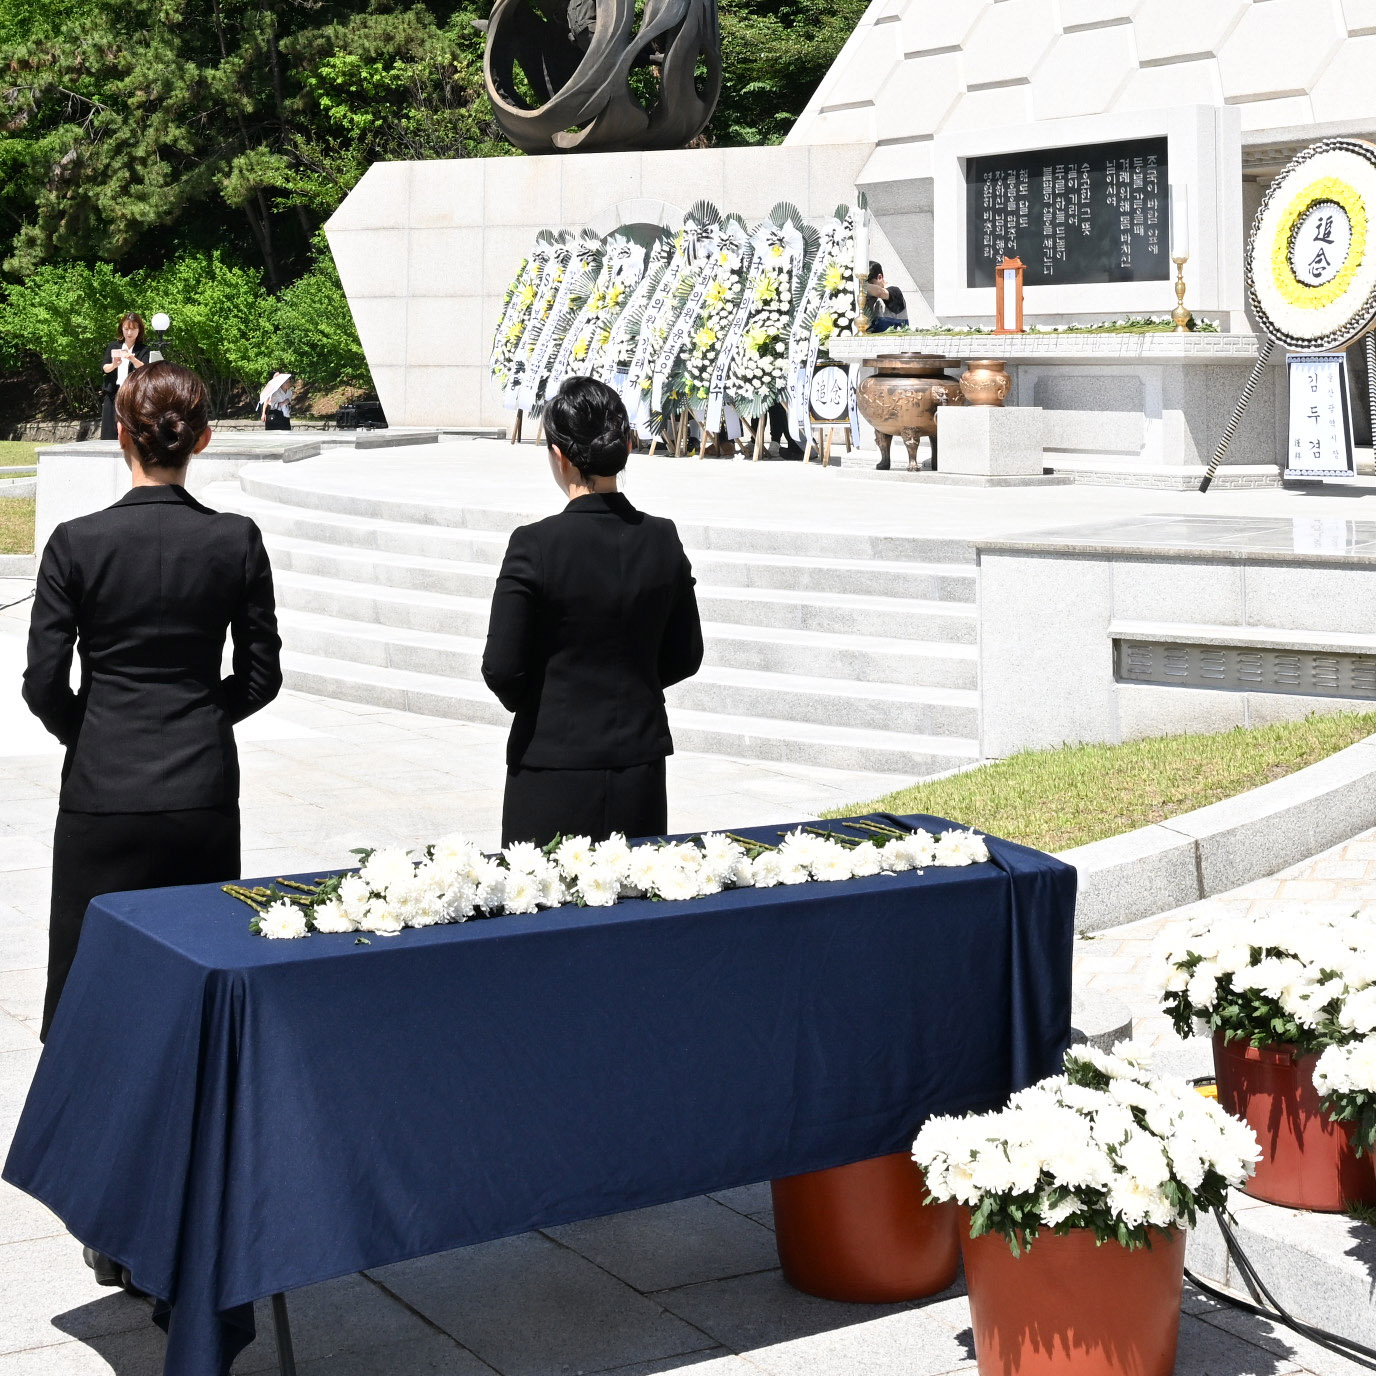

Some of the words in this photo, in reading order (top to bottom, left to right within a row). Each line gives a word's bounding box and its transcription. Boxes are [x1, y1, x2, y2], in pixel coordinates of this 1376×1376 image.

[1106, 160, 1116, 207] 님이시여
[1056, 196, 1065, 224] 하늘
[1081, 208, 1091, 218] 그
[1147, 198, 1158, 224] 바람
[1308, 215, 1334, 277] 追念
